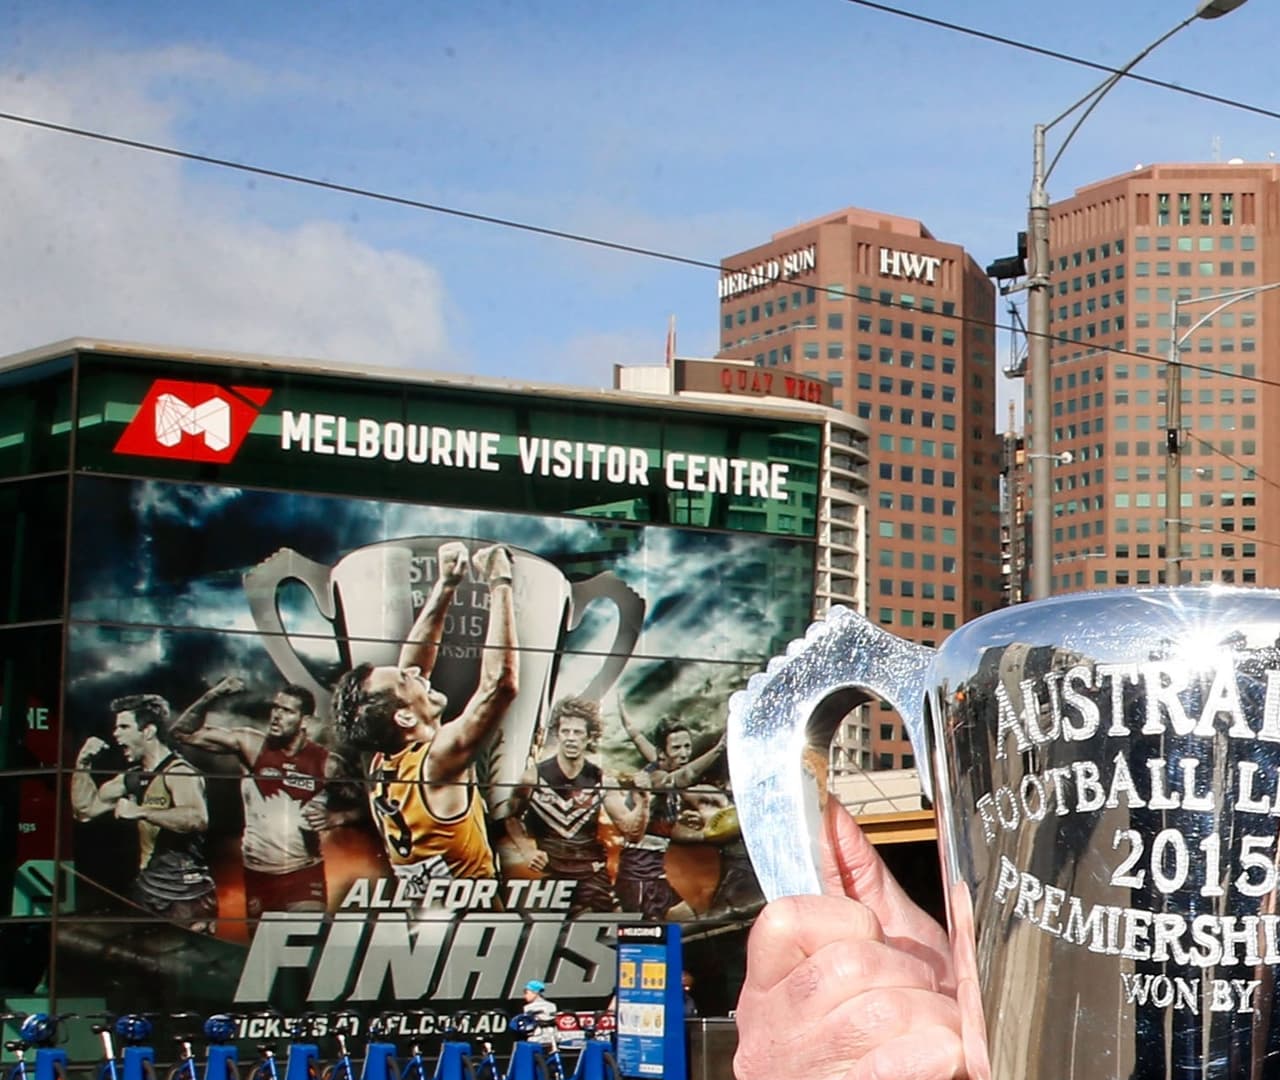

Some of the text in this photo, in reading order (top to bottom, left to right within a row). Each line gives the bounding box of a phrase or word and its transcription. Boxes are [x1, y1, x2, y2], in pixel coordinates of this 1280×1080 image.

[717, 248, 816, 298] HERALD SUN
[879, 248, 941, 282] HWT
[720, 368, 823, 404] QUAY WEST
[281, 410, 789, 500] MELBOURNE VISITOR CENTRE
[976, 750, 1215, 843] FOOTBALL
[1110, 829, 1277, 898] 2015
[341, 878, 578, 910] ALL FOR THE
[233, 911, 644, 1003] FINALS
[1120, 972, 1263, 1015] WON BY
[229, 1017, 329, 1039] ICKES
